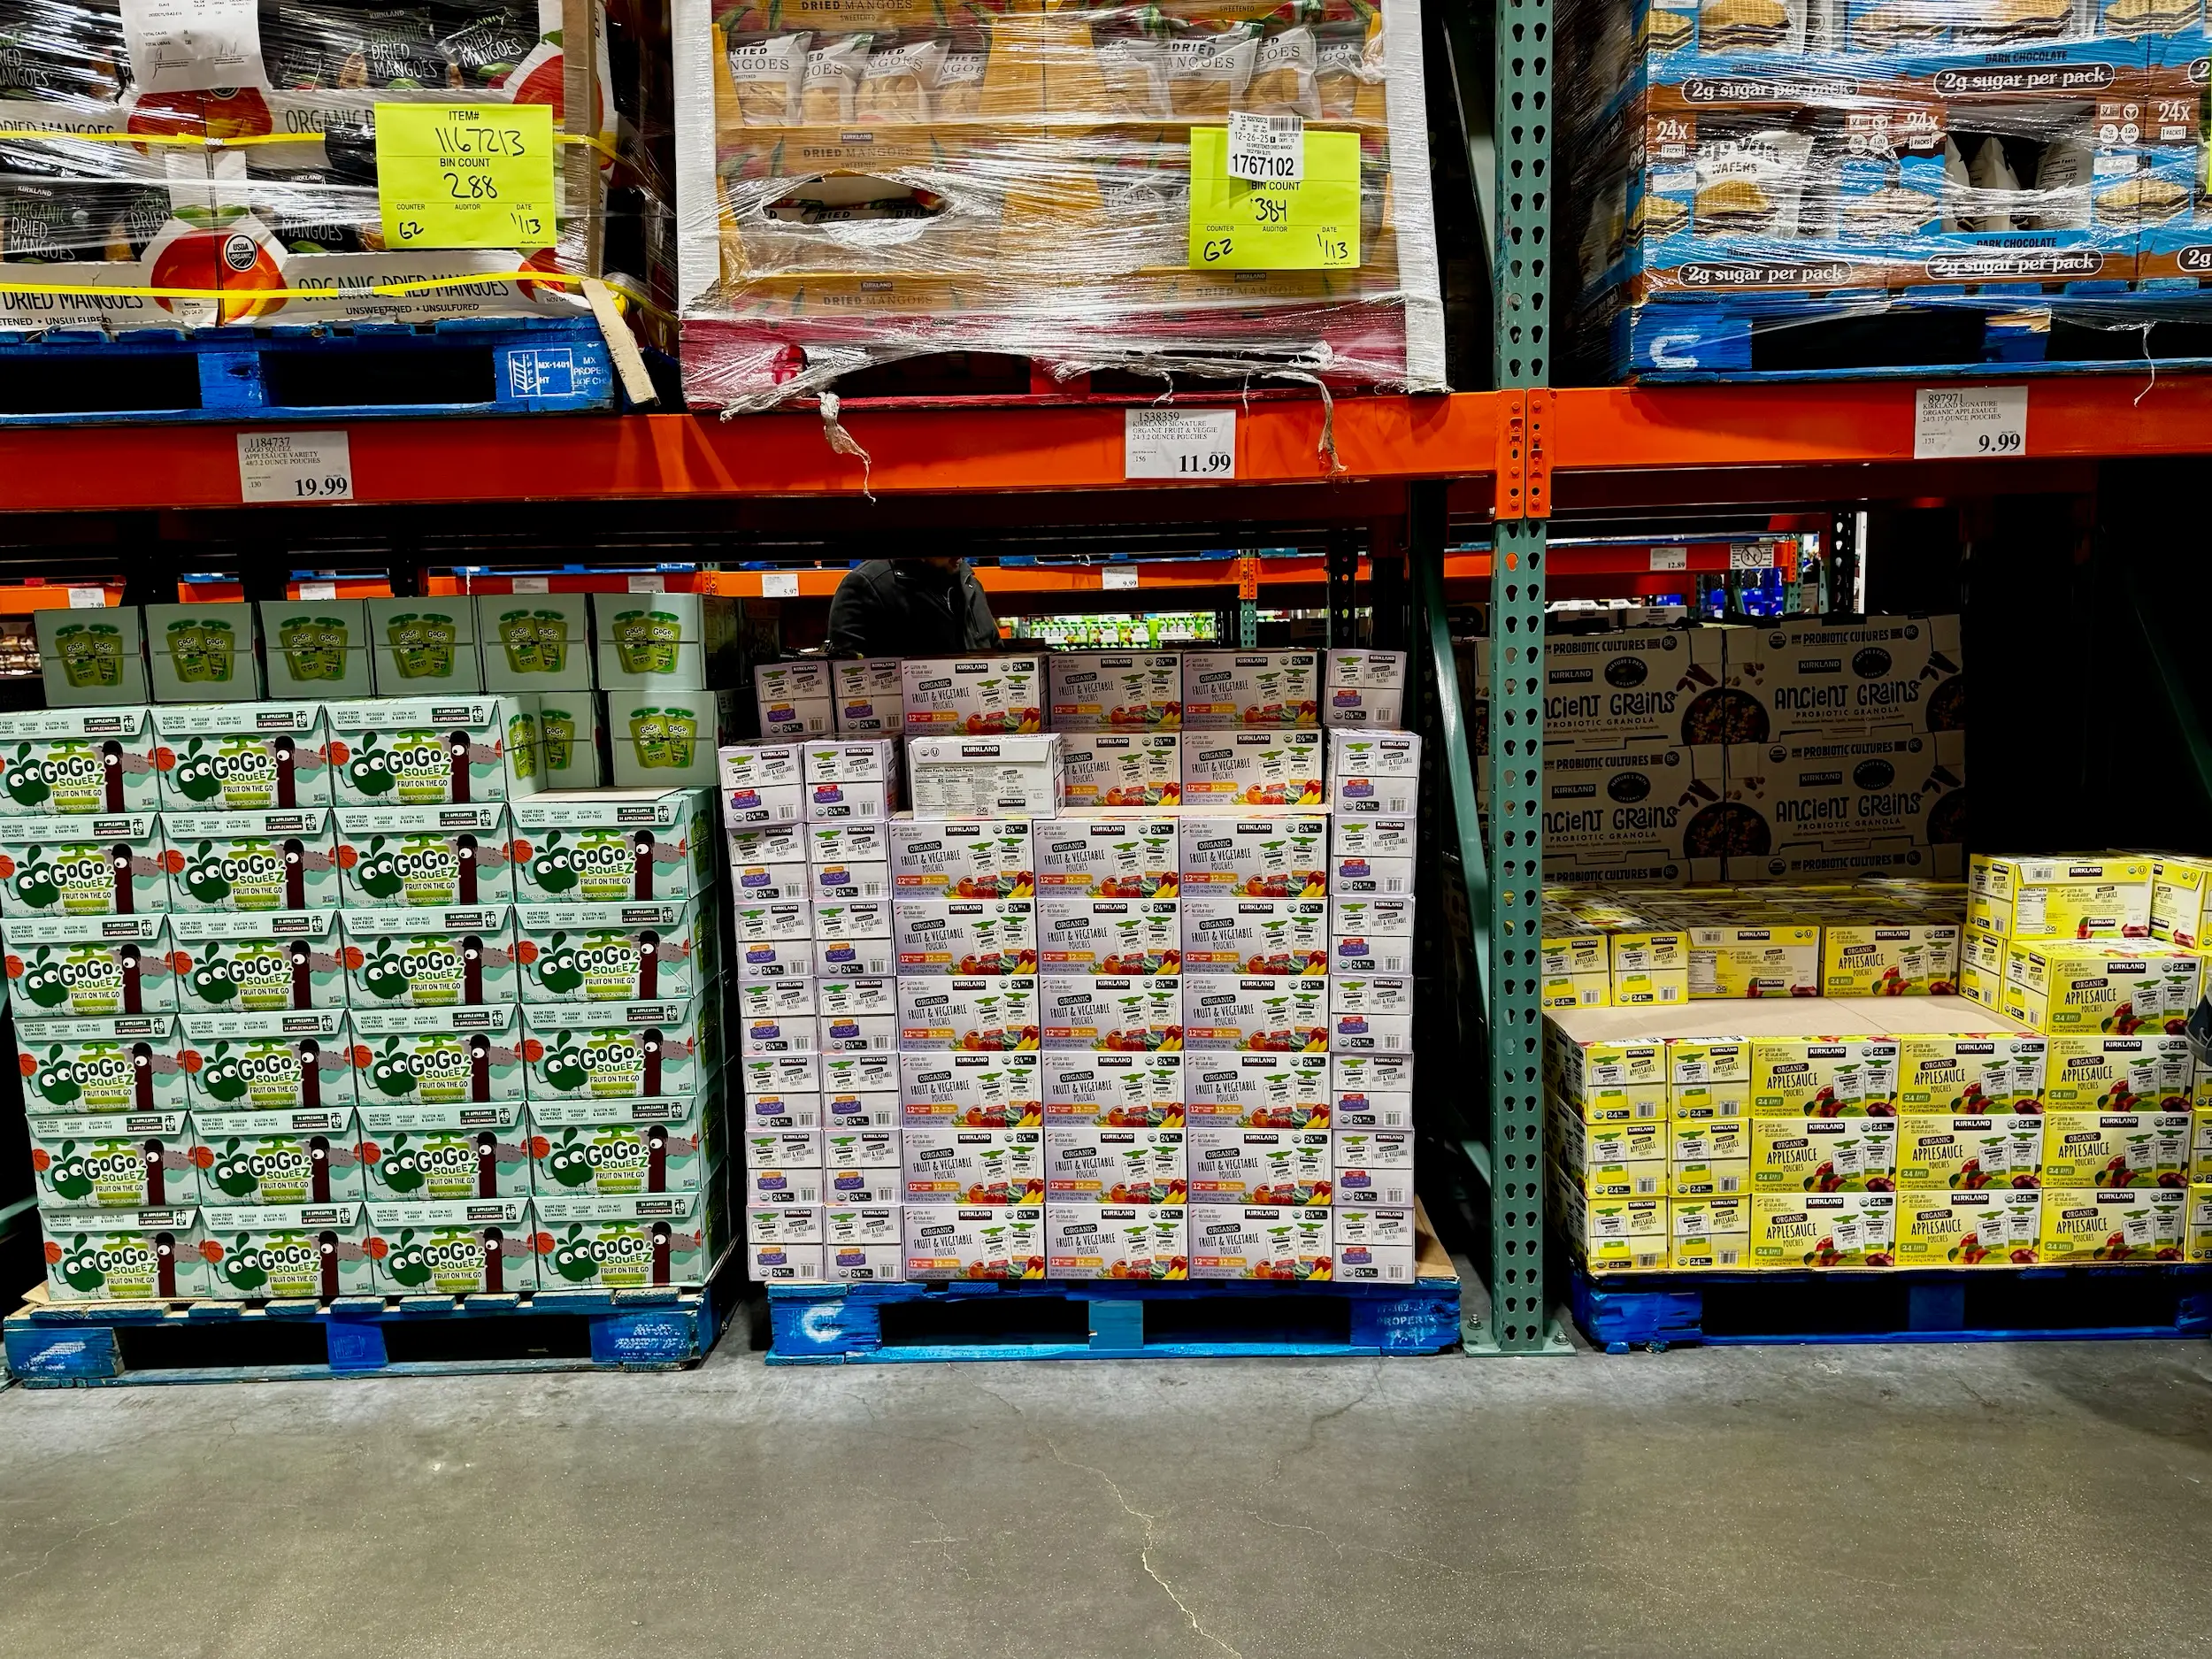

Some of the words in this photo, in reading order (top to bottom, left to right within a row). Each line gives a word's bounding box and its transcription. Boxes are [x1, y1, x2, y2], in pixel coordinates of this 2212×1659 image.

[370, 9, 404, 19] KIRKLAND
[371, 22, 428, 44] ORGANIC
[457, 28, 493, 53] DRIED
[371, 44, 410, 60] DRIED
[461, 37, 523, 67] MANGOES
[1985, 52, 2011, 64] DARK
[2013, 50, 2067, 63] CHOCOLATE
[373, 59, 437, 79] MANGOES
[1945, 73, 1968, 91] 2g
[1972, 73, 2023, 92] sugar
[2028, 72, 2058, 89] per
[2063, 66, 2106, 86] pack
[449, 111, 480, 121] ITEM#
[2158, 103, 2191, 122] 24x
[1235, 132, 1268, 142] 12-26-25
[1656, 120, 1688, 141] 24x
[435, 127, 525, 156] 1167213
[803, 149, 841, 157] DRIED
[846, 148, 913, 157] MANGOES
[441, 158, 457, 167] BIN
[458, 158, 490, 167] COUNT
[1233, 154, 1294, 176] 1767102
[18, 185, 52, 196] KIRKLAND
[444, 173, 497, 198] 288
[1269, 181, 1301, 190] COUNT
[12, 198, 66, 224] ORGANIC
[1256, 198, 1286, 222] 384
[11, 216, 47, 239] DRIED
[282, 219, 343, 242] MANGOES
[511, 213, 541, 234] 1/13
[11, 238, 75, 261] MANGOES
[1317, 234, 1348, 259] 1/13
[1977, 240, 2001, 249] DARK
[2003, 237, 2056, 248] CHOCOLATE
[1936, 258, 1958, 276] 2g
[1963, 257, 2014, 277] sugar
[2018, 256, 2049, 274] per
[2052, 252, 2094, 272] pack
[1688, 266, 1713, 283] 2g
[1715, 267, 1763, 283] sugar
[1768, 266, 1798, 283] per
[1802, 264, 1842, 281] pack
[346, 305, 412, 315] UNSWEETENED
[422, 303, 480, 312] UNSULFURED
[824, 296, 862, 305] DRIED
[583, 356, 596, 365] MX
[1928, 394, 1962, 403] 897971
[1139, 412, 1179, 421] 1538359
[250, 437, 290, 448] 1184737
[1978, 434, 2021, 452] 9.99
[1179, 455, 1231, 472] 11.99
[295, 478, 347, 495] 19.99
[1553, 641, 1600, 654] PROBIOTIC
[1602, 639, 1646, 651] CULTURES
[386, 747, 442, 773] GoGo
[1201, 920, 1232, 929] ORGANIC
[1192, 932, 1209, 943] FRUIT
[1212, 932, 1218, 941] &
[1219, 928, 1253, 941] VEGETABLE
[1213, 941, 1235, 949] POUCHES
[2065, 988, 2116, 1005] APPLESAUCE
[2081, 1004, 2102, 1013] POUCHES
[1776, 1214, 1803, 1224] ORGANIC
[1767, 1223, 1817, 1239] APPLESAUCE
[590, 1237, 643, 1261] GoGo
